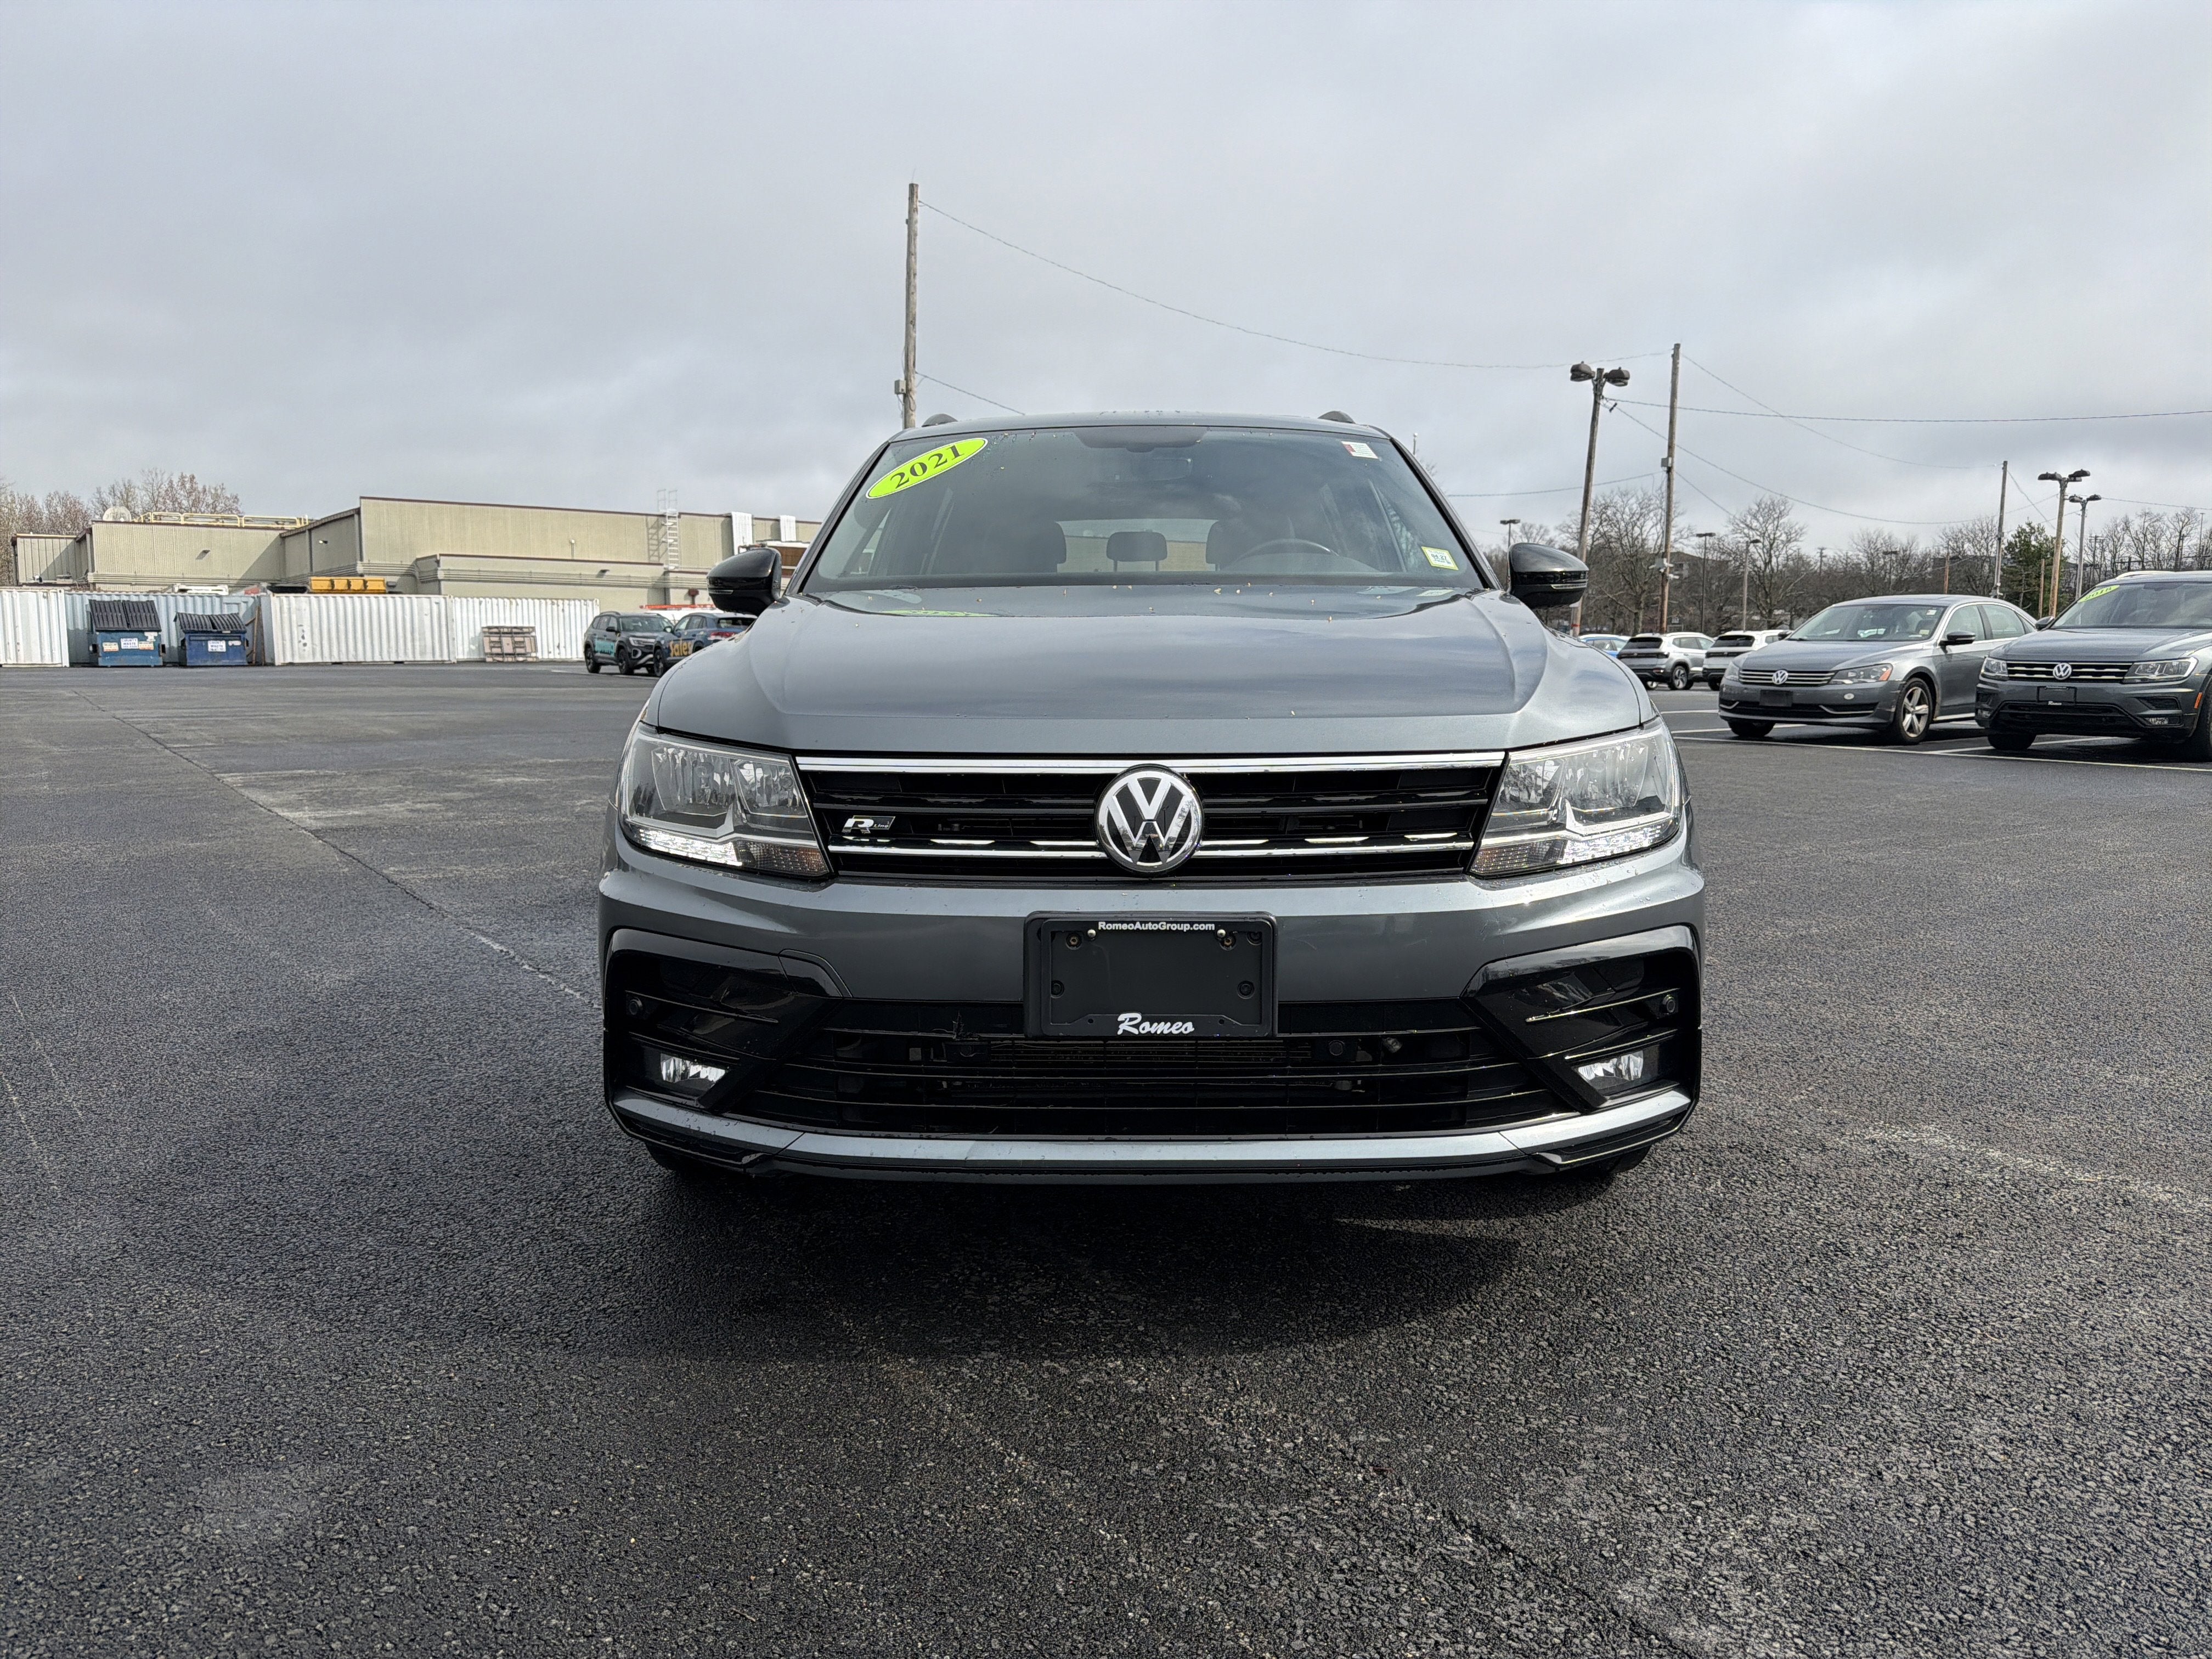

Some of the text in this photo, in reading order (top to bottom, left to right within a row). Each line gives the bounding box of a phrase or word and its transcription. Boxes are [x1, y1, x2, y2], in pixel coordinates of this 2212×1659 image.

[890, 445, 964, 489] 2021
[2053, 663, 2072, 680] VW
[842, 818, 874, 833] R
[1101, 773, 1196, 868] VW
[1098, 922, 1215, 932] RomeoAutoGroup.com
[1117, 1013, 1195, 1035] Romeo
